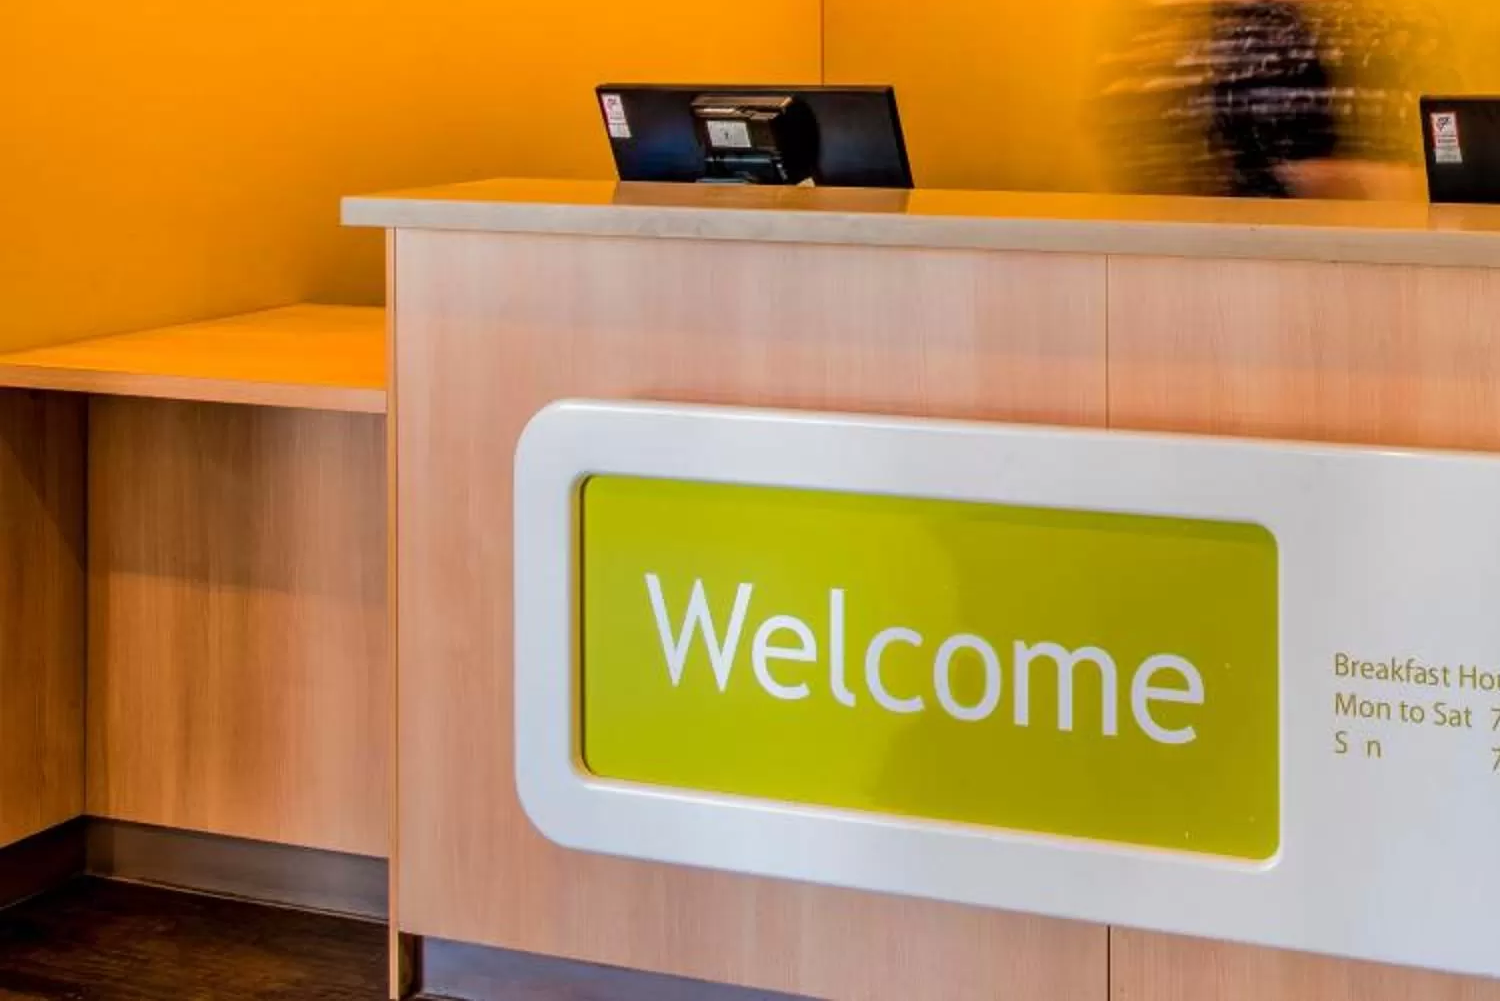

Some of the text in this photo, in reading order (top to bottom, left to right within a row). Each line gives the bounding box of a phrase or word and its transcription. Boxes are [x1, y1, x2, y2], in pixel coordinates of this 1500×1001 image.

[645, 572, 1205, 744] Welcome
[1334, 652, 1451, 689] Breakfast
[1334, 692, 1391, 721] Mon
[1400, 700, 1425, 725] to
[1433, 702, 1473, 729] Sat
[1334, 730, 1382, 759] Sn
